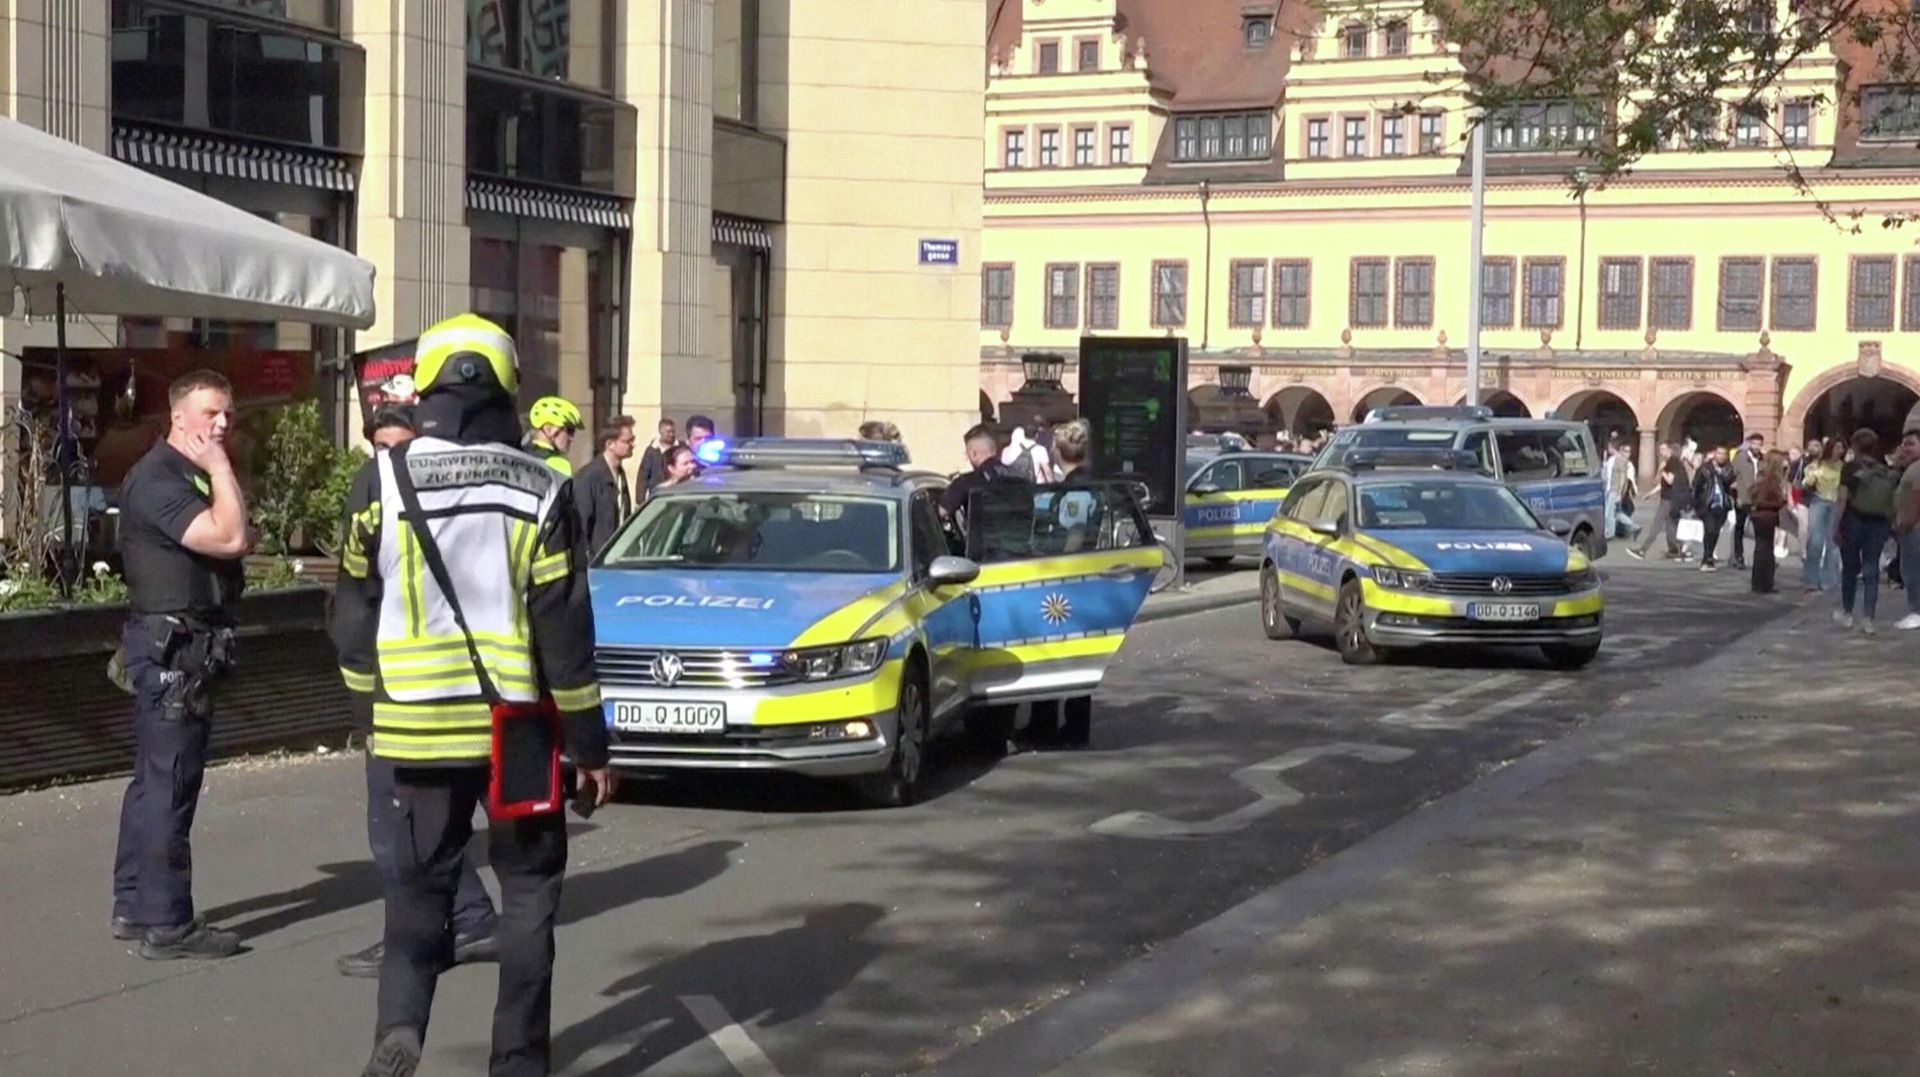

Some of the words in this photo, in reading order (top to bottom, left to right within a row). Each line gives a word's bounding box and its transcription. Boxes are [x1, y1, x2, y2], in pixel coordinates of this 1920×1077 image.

[1198, 506, 1241, 522] POLIZEI
[1436, 542, 1533, 552] POLIZEI
[614, 595, 775, 610] POLIZEI
[1510, 606, 1538, 617] 1146
[617, 704, 643, 724] DD
[673, 707, 722, 726] 1009
